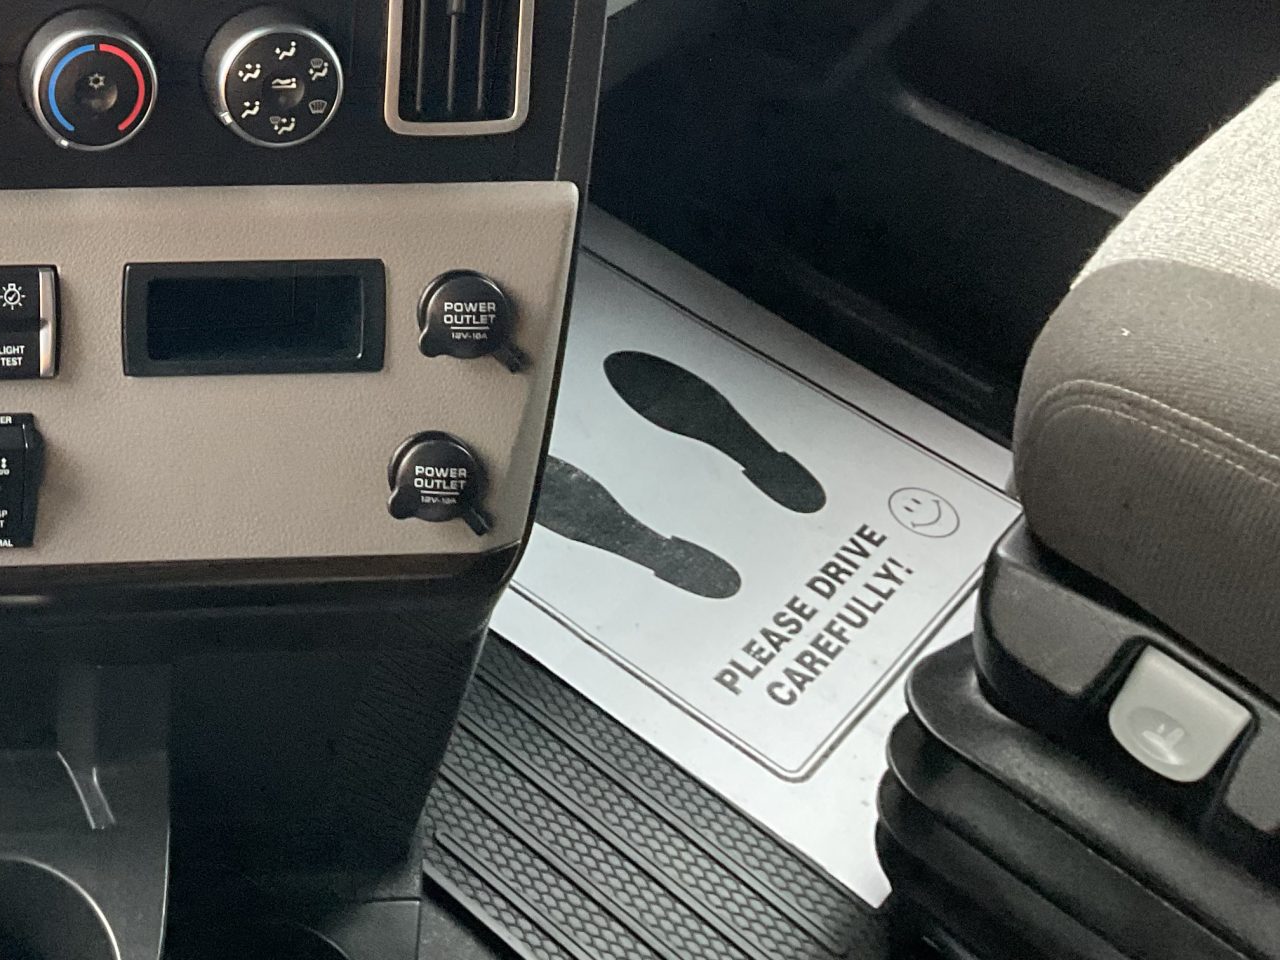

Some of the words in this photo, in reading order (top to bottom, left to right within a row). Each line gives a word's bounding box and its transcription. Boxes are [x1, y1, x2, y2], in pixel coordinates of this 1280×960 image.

[444, 302, 496, 313] POWER
[443, 314, 496, 325] OUTLET
[0, 356, 24, 367] TEST
[415, 465, 467, 478] POWER
[413, 478, 467, 490] OUTLET
[712, 595, 819, 697] PLEASE
[805, 523, 888, 600] DRIVE
[766, 556, 915, 707] CAREFULLY!
